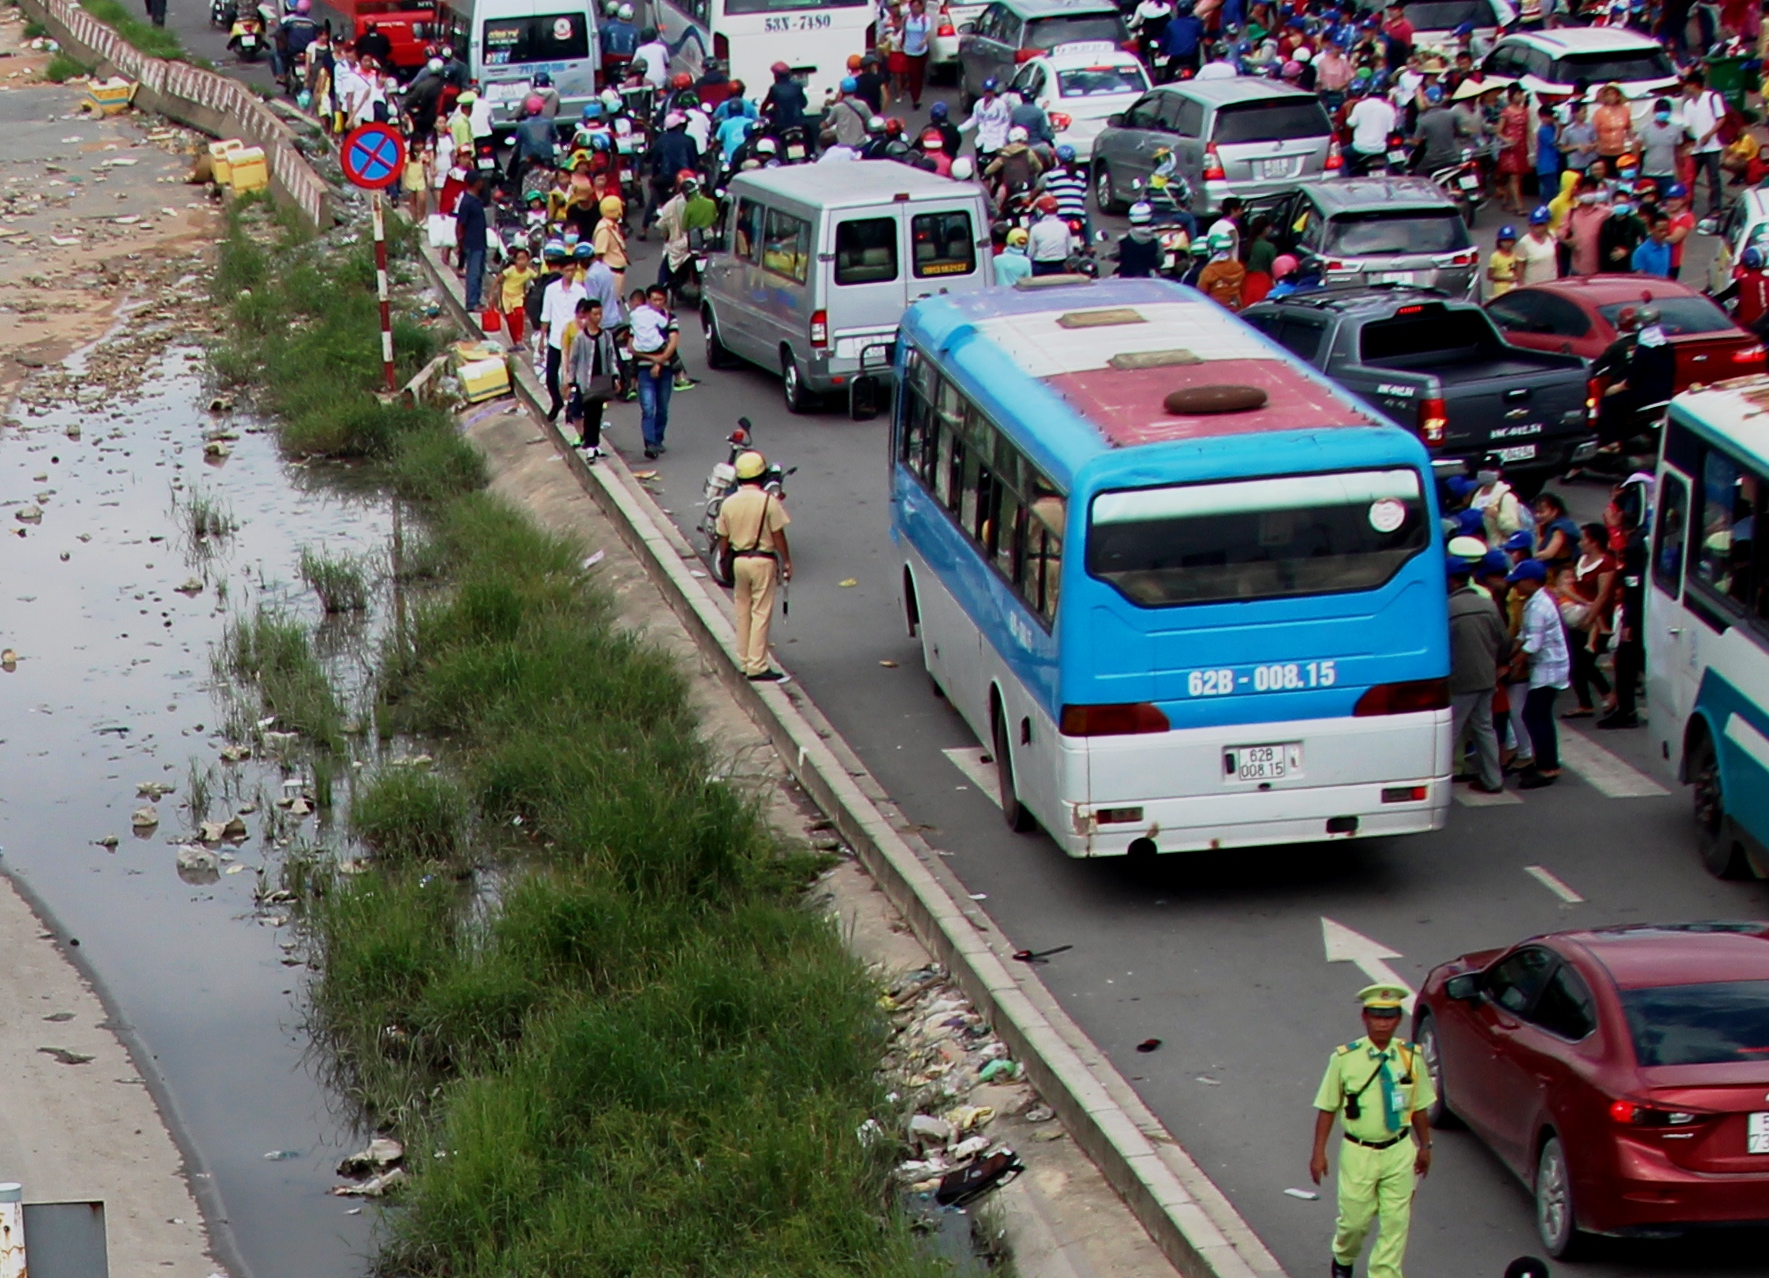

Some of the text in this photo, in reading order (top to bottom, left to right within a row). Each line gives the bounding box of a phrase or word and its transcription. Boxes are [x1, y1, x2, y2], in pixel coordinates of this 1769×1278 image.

[1188, 669, 1234, 696] 62B
[1254, 661, 1335, 692] 008.15
[1250, 747, 1274, 762] 62B
